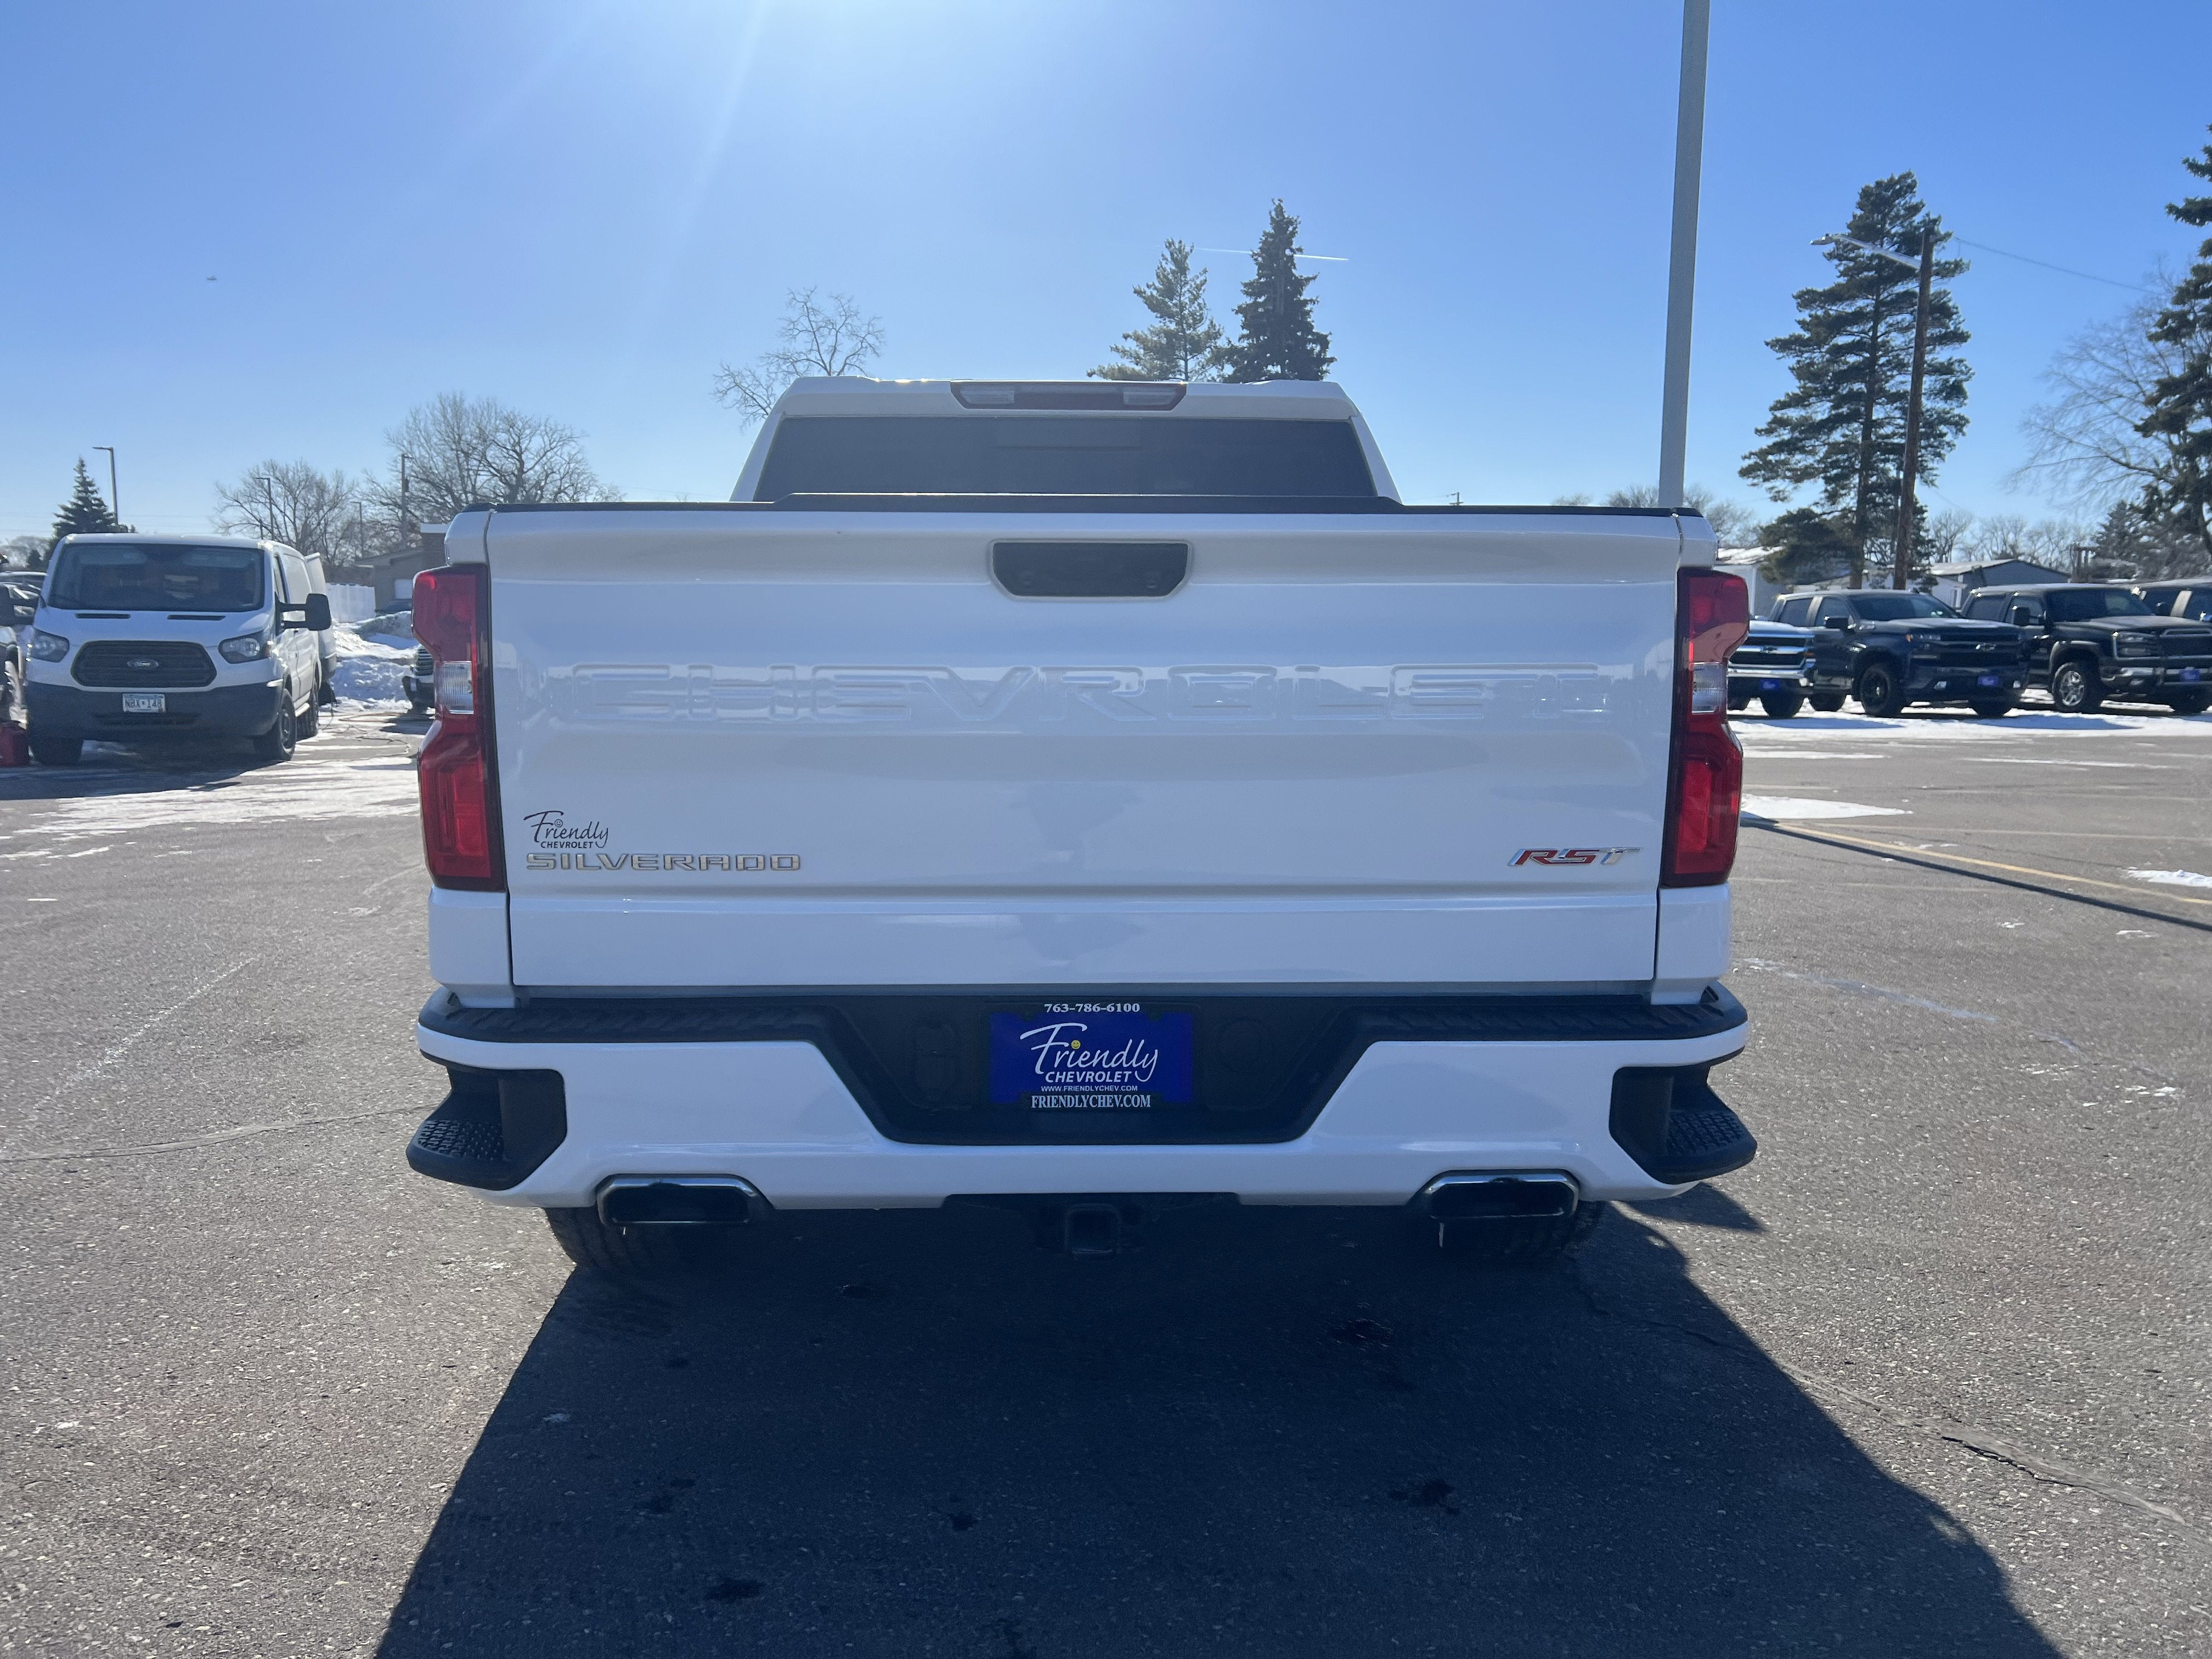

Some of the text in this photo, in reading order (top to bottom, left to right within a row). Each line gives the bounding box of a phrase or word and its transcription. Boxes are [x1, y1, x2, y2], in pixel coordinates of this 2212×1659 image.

[572, 663, 1599, 720] CHEVROLET
[523, 810, 609, 848] Friendly
[527, 853, 801, 871] SILVERADO
[1508, 847, 1641, 866] RST
[1044, 1003, 1140, 1013] 763-786-6100
[1020, 1023, 1158, 1082] Friendly
[1045, 1071, 1132, 1082] CHEVROLET
[1031, 1095, 1151, 1108] FRIENDLYCHEV.COM
